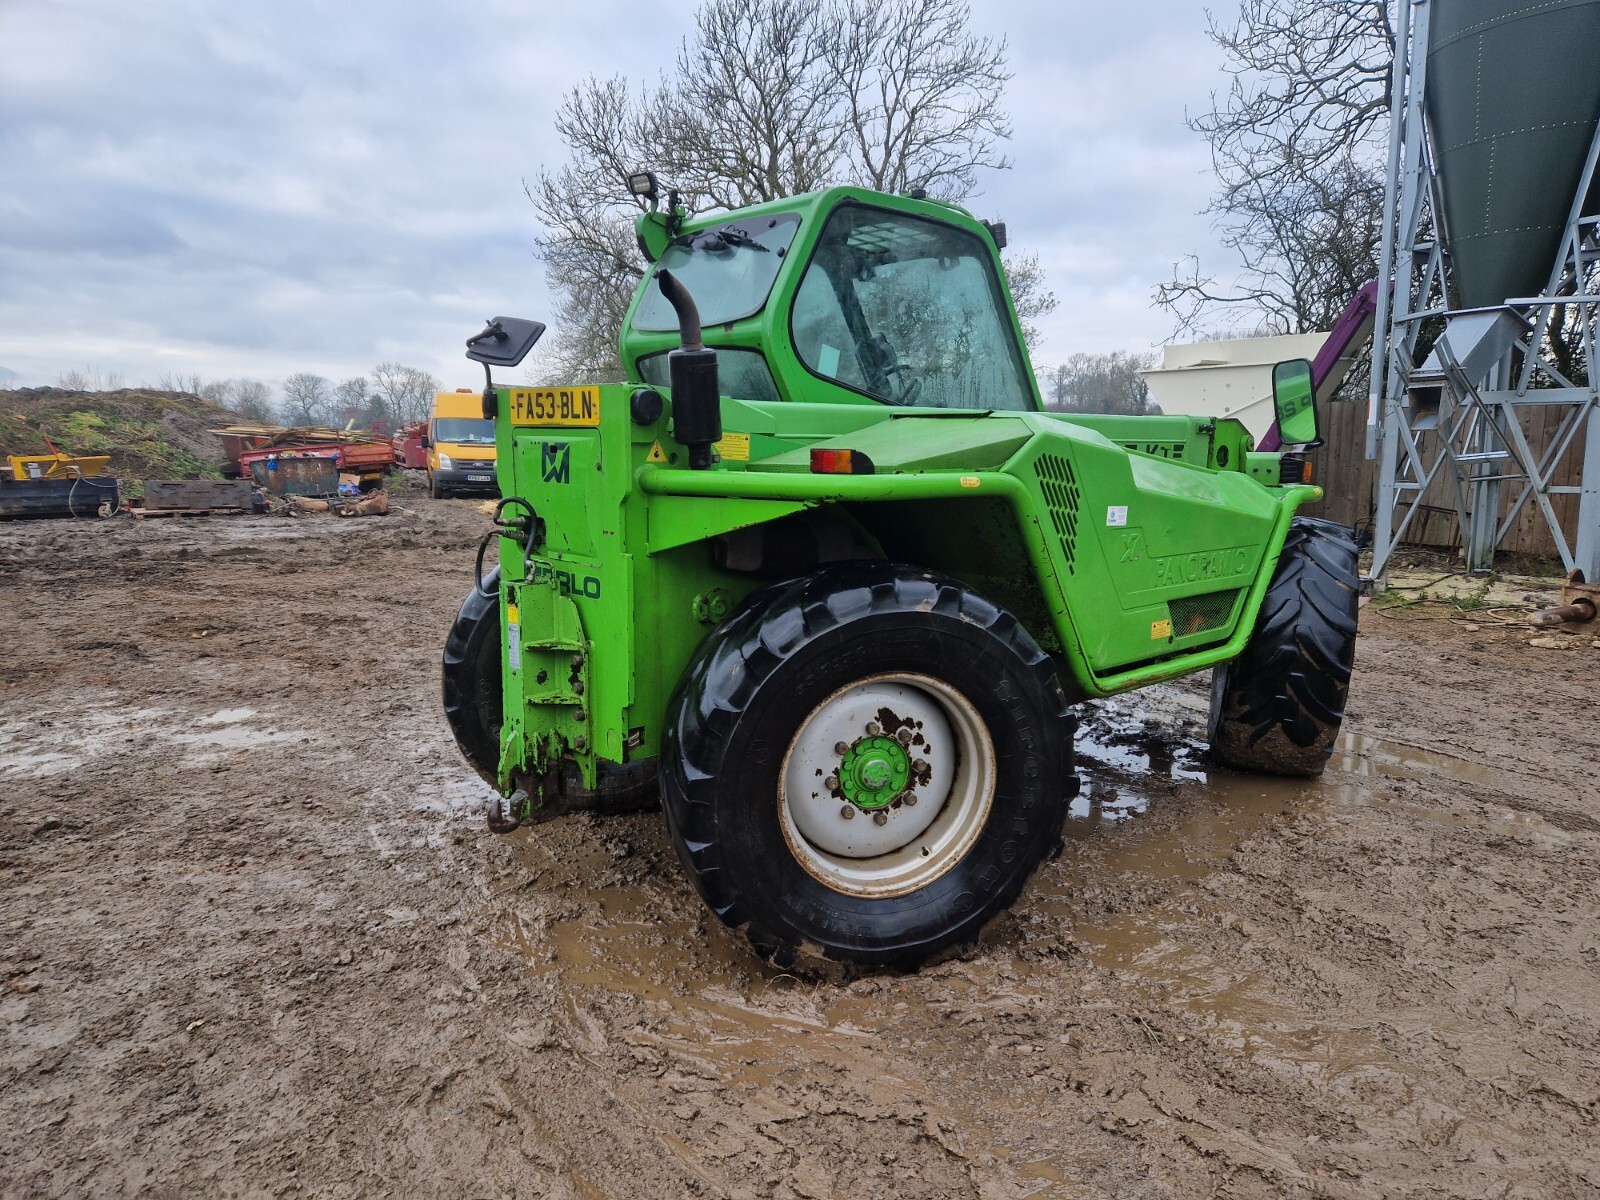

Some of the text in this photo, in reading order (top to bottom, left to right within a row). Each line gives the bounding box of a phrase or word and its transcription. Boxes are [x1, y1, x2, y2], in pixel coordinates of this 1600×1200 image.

[516, 390, 593, 419] FA53 BLN
[523, 565, 602, 600] RLO
[1155, 549, 1246, 587] PANORAMIC
